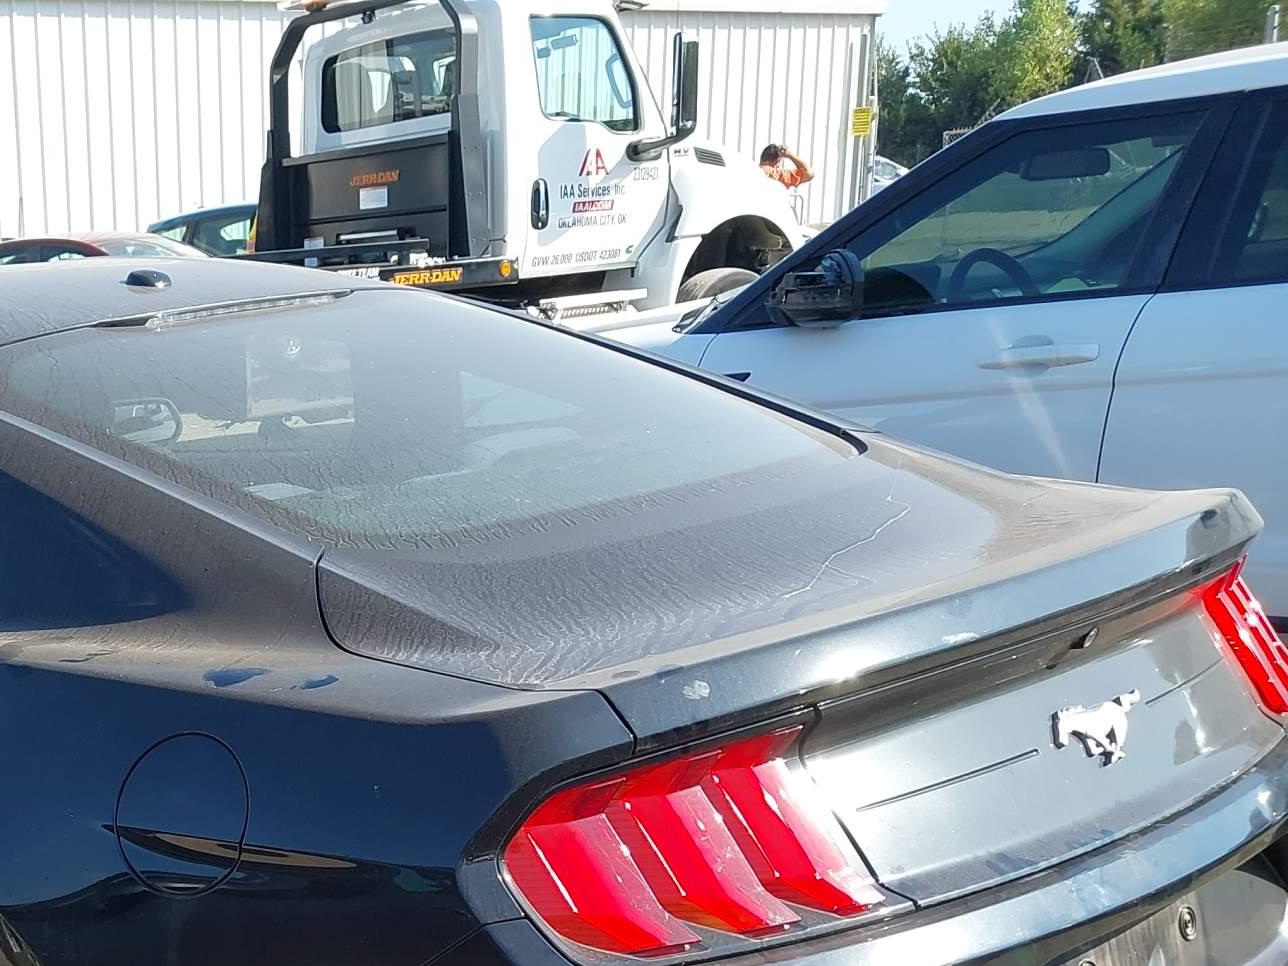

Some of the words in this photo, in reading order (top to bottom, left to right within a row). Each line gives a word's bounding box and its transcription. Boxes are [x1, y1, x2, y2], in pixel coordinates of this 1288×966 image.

[560, 184, 575, 200] IAA
[558, 216, 598, 229] OKLAHOMA
[617, 213, 627, 225] OK
[532, 255, 550, 267] GVW
[575, 250, 598, 262] USDOT
